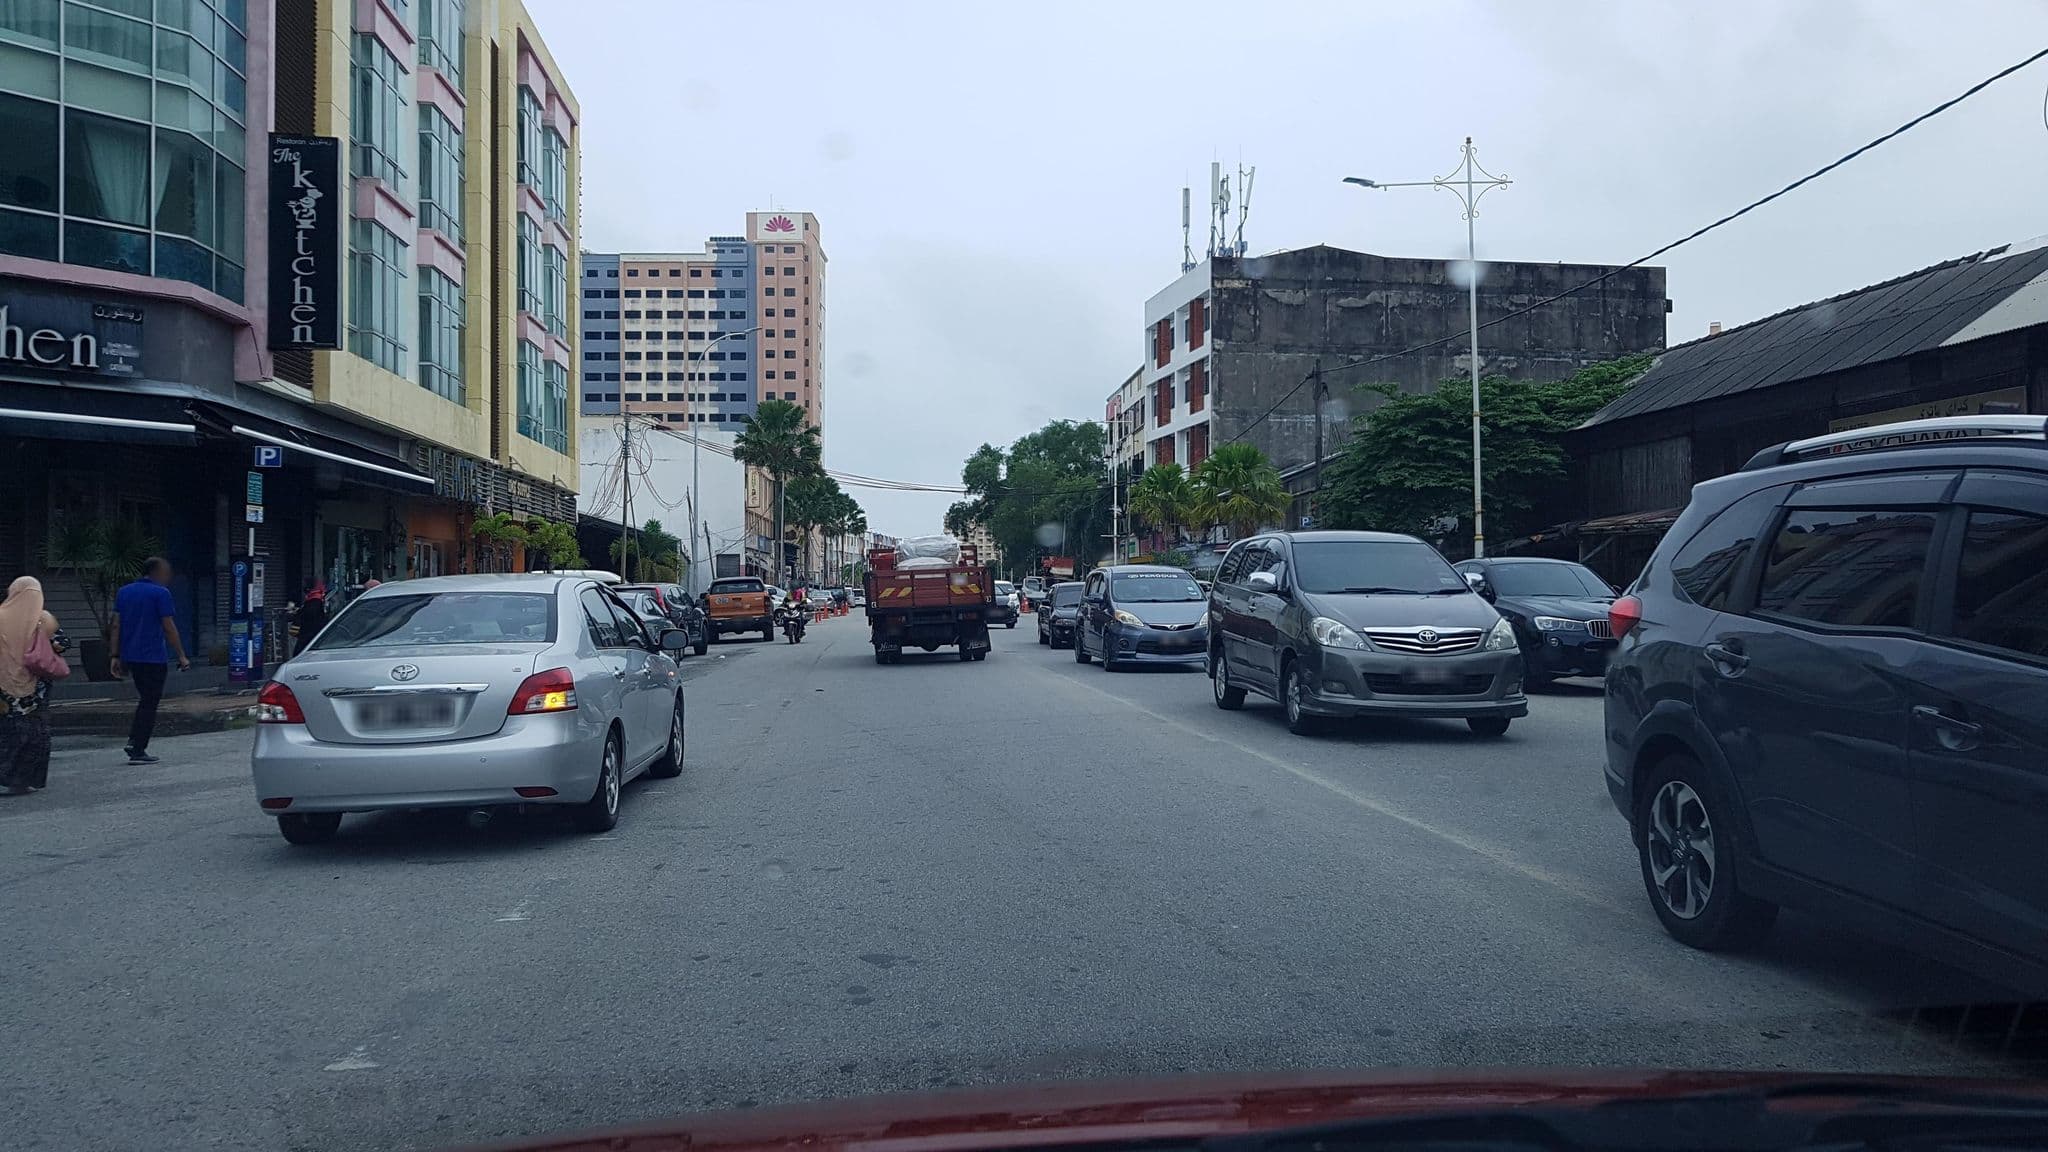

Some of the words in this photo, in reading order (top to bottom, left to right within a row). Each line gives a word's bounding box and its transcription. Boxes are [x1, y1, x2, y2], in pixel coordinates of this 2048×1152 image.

[273, 147, 301, 163] The
[260, 447, 277, 466] P
[1302, 517, 1310, 527] P
